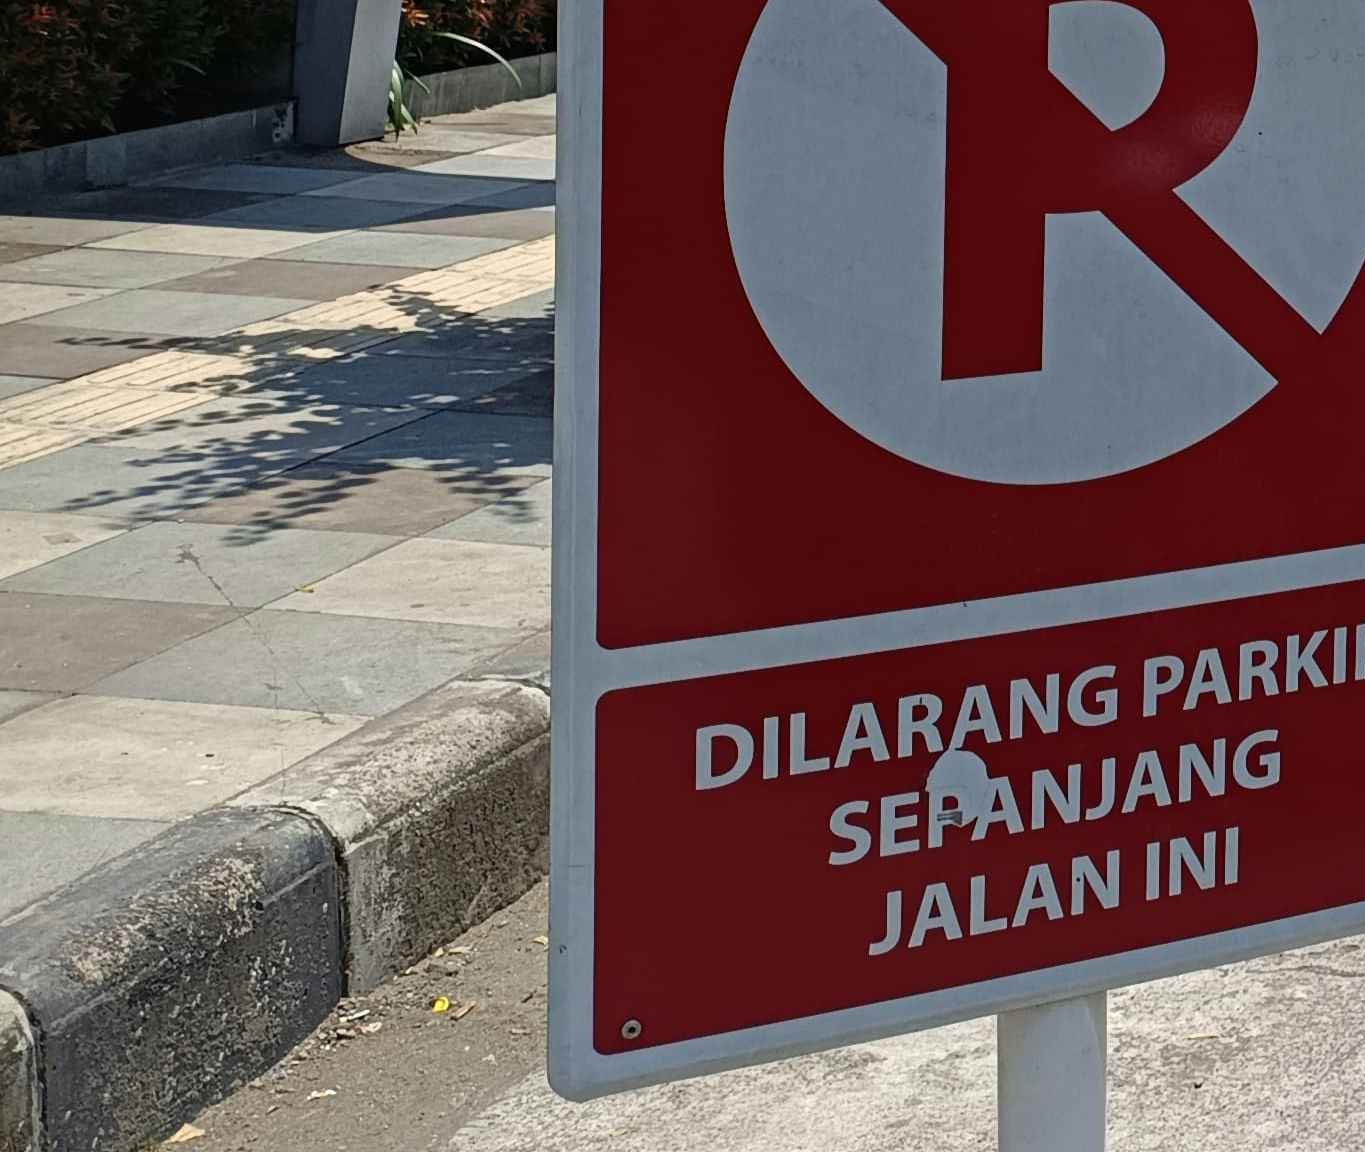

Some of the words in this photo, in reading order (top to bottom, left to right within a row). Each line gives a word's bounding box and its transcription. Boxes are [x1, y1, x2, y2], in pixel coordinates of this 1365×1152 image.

[694, 665, 1118, 791] DILARANG
[867, 850, 1120, 957] JALAN
[1145, 826, 1240, 902] INI
